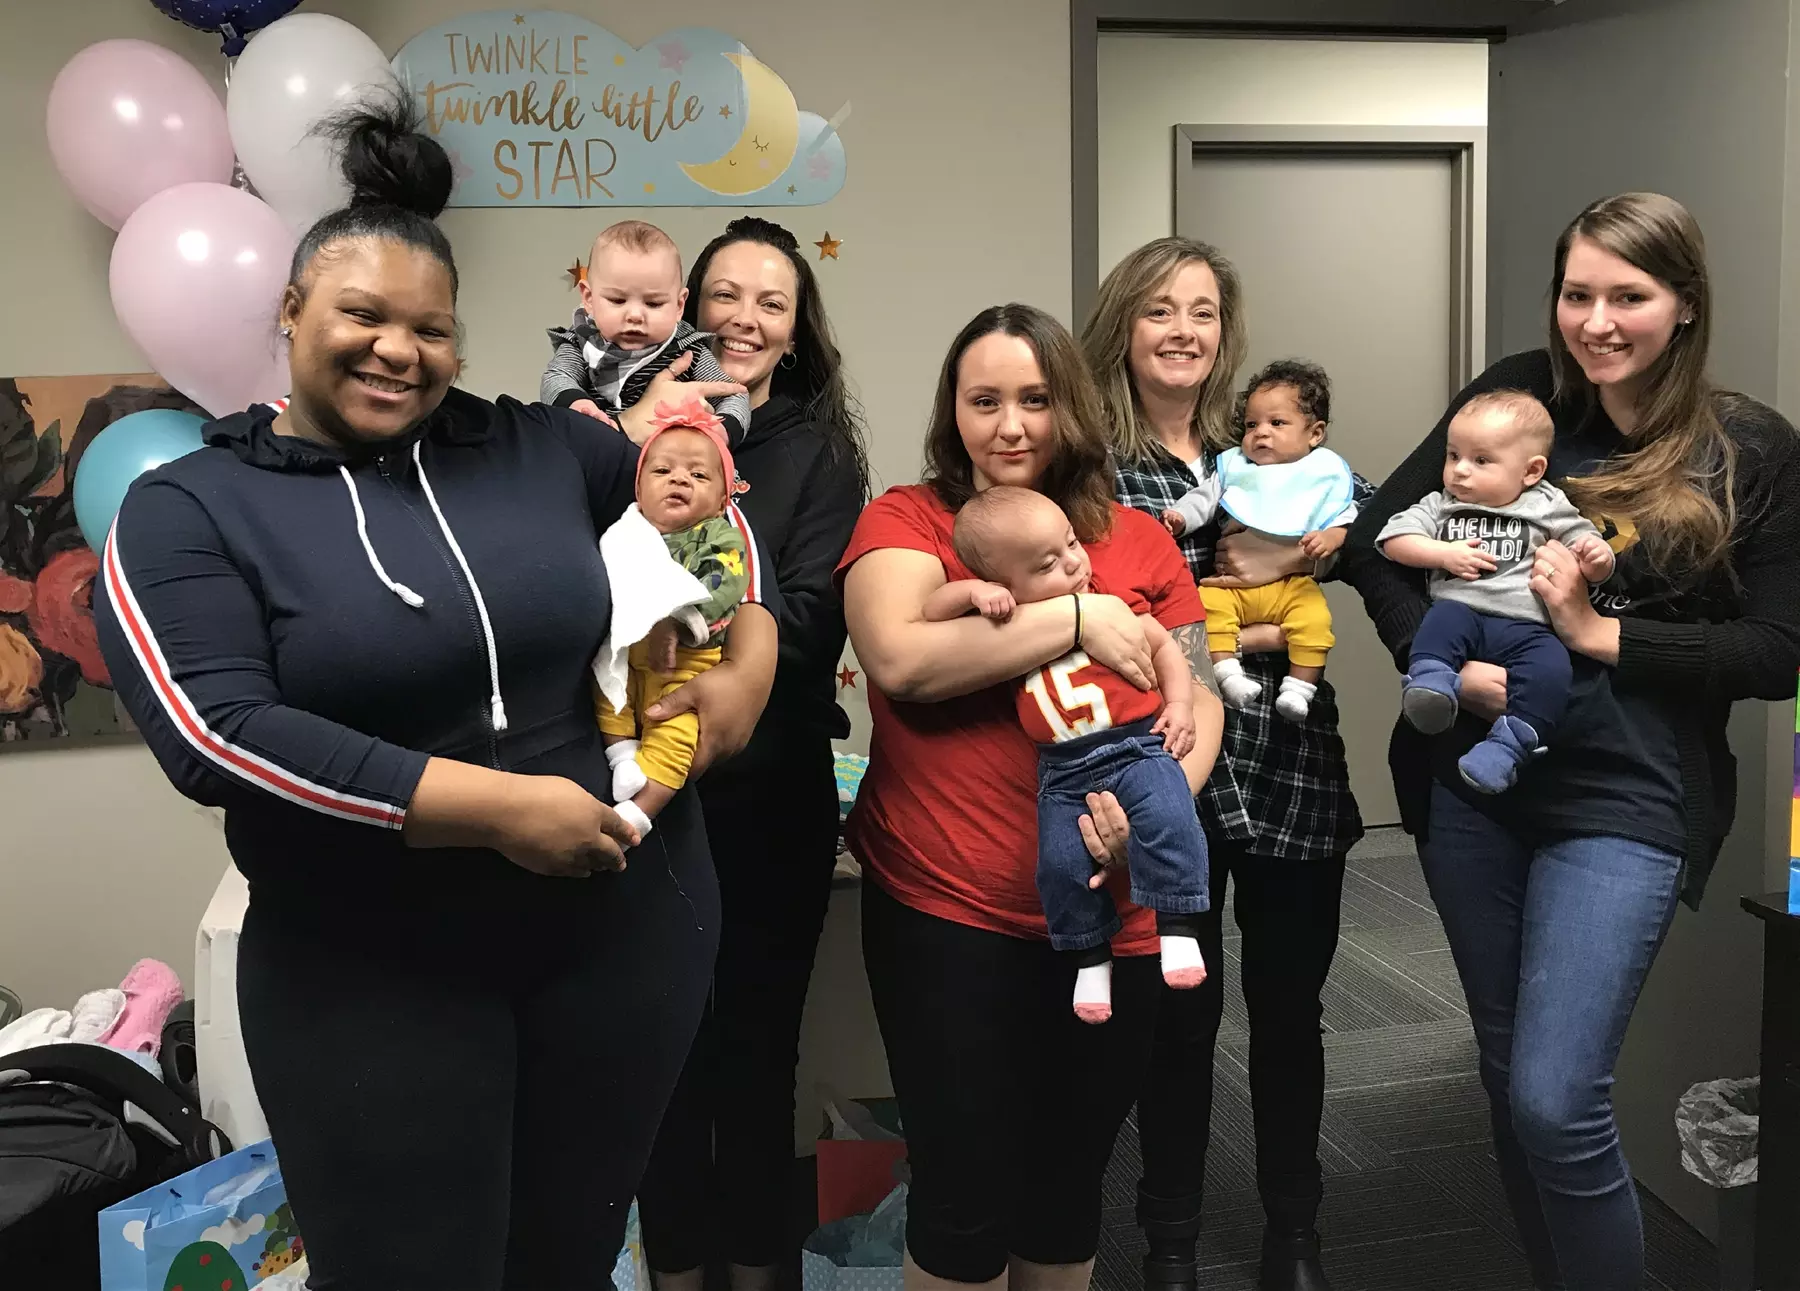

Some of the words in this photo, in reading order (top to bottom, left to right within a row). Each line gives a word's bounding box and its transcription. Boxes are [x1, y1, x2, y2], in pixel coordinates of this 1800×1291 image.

[444, 29, 589, 75] TWINKLE
[419, 79, 586, 134] twinkle
[592, 79, 704, 142] little
[493, 138, 617, 200] STAR
[1448, 517, 1522, 540] HELLO
[1025, 651, 1113, 744] 15
